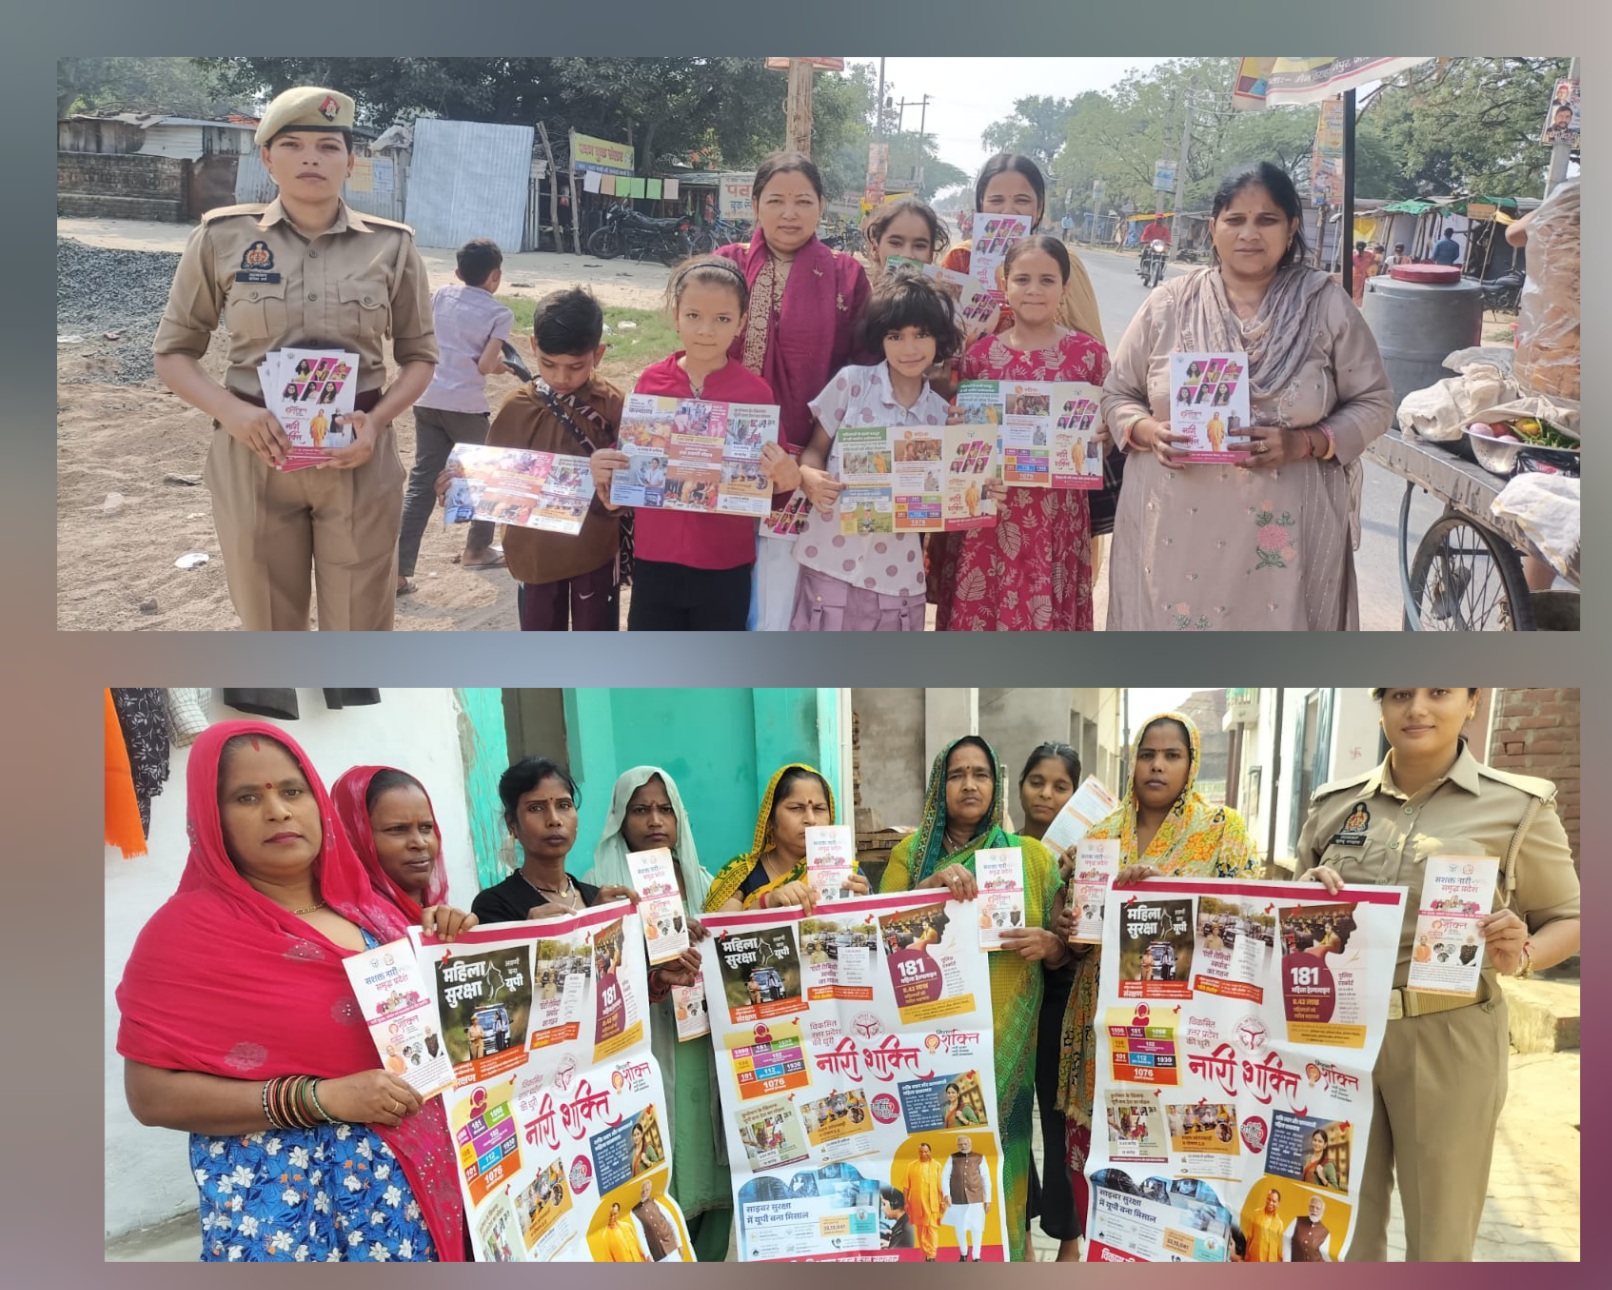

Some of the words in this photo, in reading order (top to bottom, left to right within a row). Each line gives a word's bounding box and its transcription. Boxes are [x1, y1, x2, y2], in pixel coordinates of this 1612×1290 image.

[725, 182, 752, 198] पव
[1127, 905, 1161, 920] महिला
[1127, 922, 1158, 939] सुरक्षा
[1173, 923, 1187, 935] यूपी
[722, 936, 758, 953] महिला
[773, 947, 789, 960] यूपी
[725, 951, 757, 969] सुरक्षा
[897, 957, 925, 976] 181
[442, 959, 486, 983] महिला
[1290, 967, 1319, 986] 181
[505, 975, 524, 992] यूपी
[444, 980, 483, 1009] सुरक्षा
[602, 986, 617, 1006] 181
[941, 1029, 980, 1053] शक्ति
[814, 1036, 863, 1083] नारी
[862, 1034, 935, 1083] शक्ति
[1134, 1068, 1154, 1077] 1076
[1187, 1043, 1239, 1097] नारी
[1242, 1051, 1309, 1118] शक्ति
[1320, 1064, 1360, 1091] शक्ति
[763, 1079, 785, 1089] 1076
[524, 1093, 560, 1150] नारी
[560, 1079, 622, 1140] शक्ति
[484, 1165, 503, 1183] 1076
